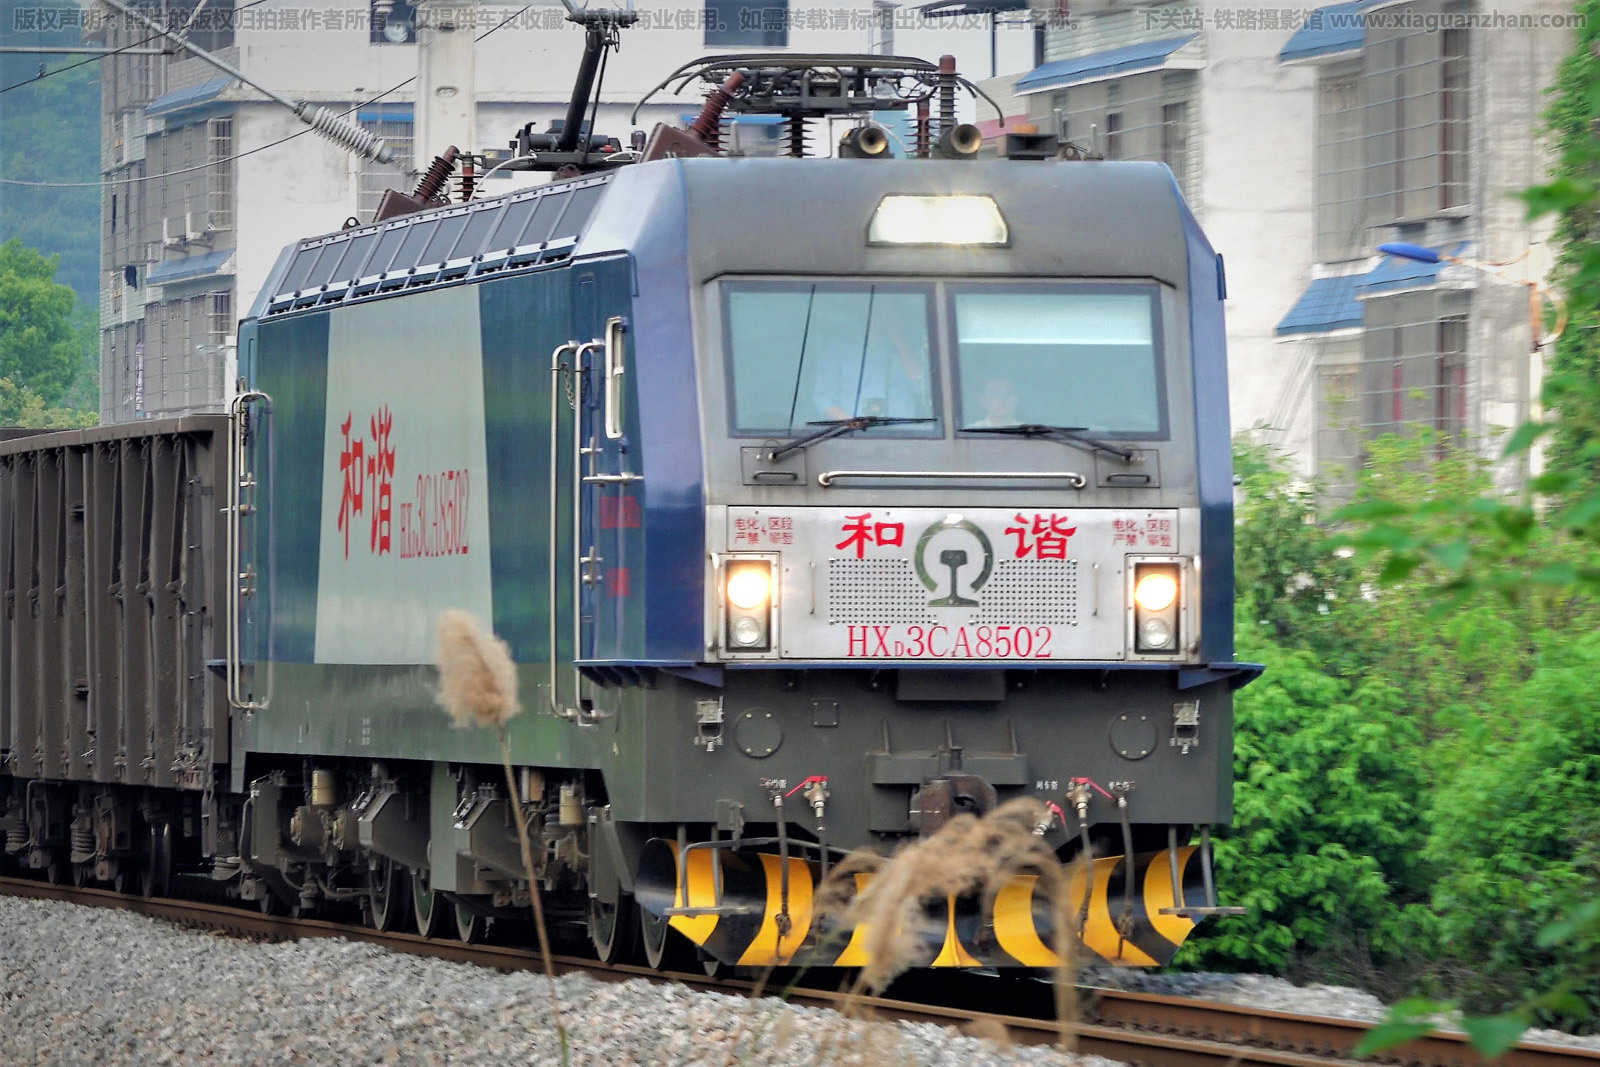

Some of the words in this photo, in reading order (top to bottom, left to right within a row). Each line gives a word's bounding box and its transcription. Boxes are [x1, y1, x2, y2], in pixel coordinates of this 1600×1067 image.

[337, 403, 396, 560] 和谐
[835, 513, 905, 560] 和
[1004, 513, 1077, 560] 谐
[846, 625, 1053, 658] HXD3CA8502
